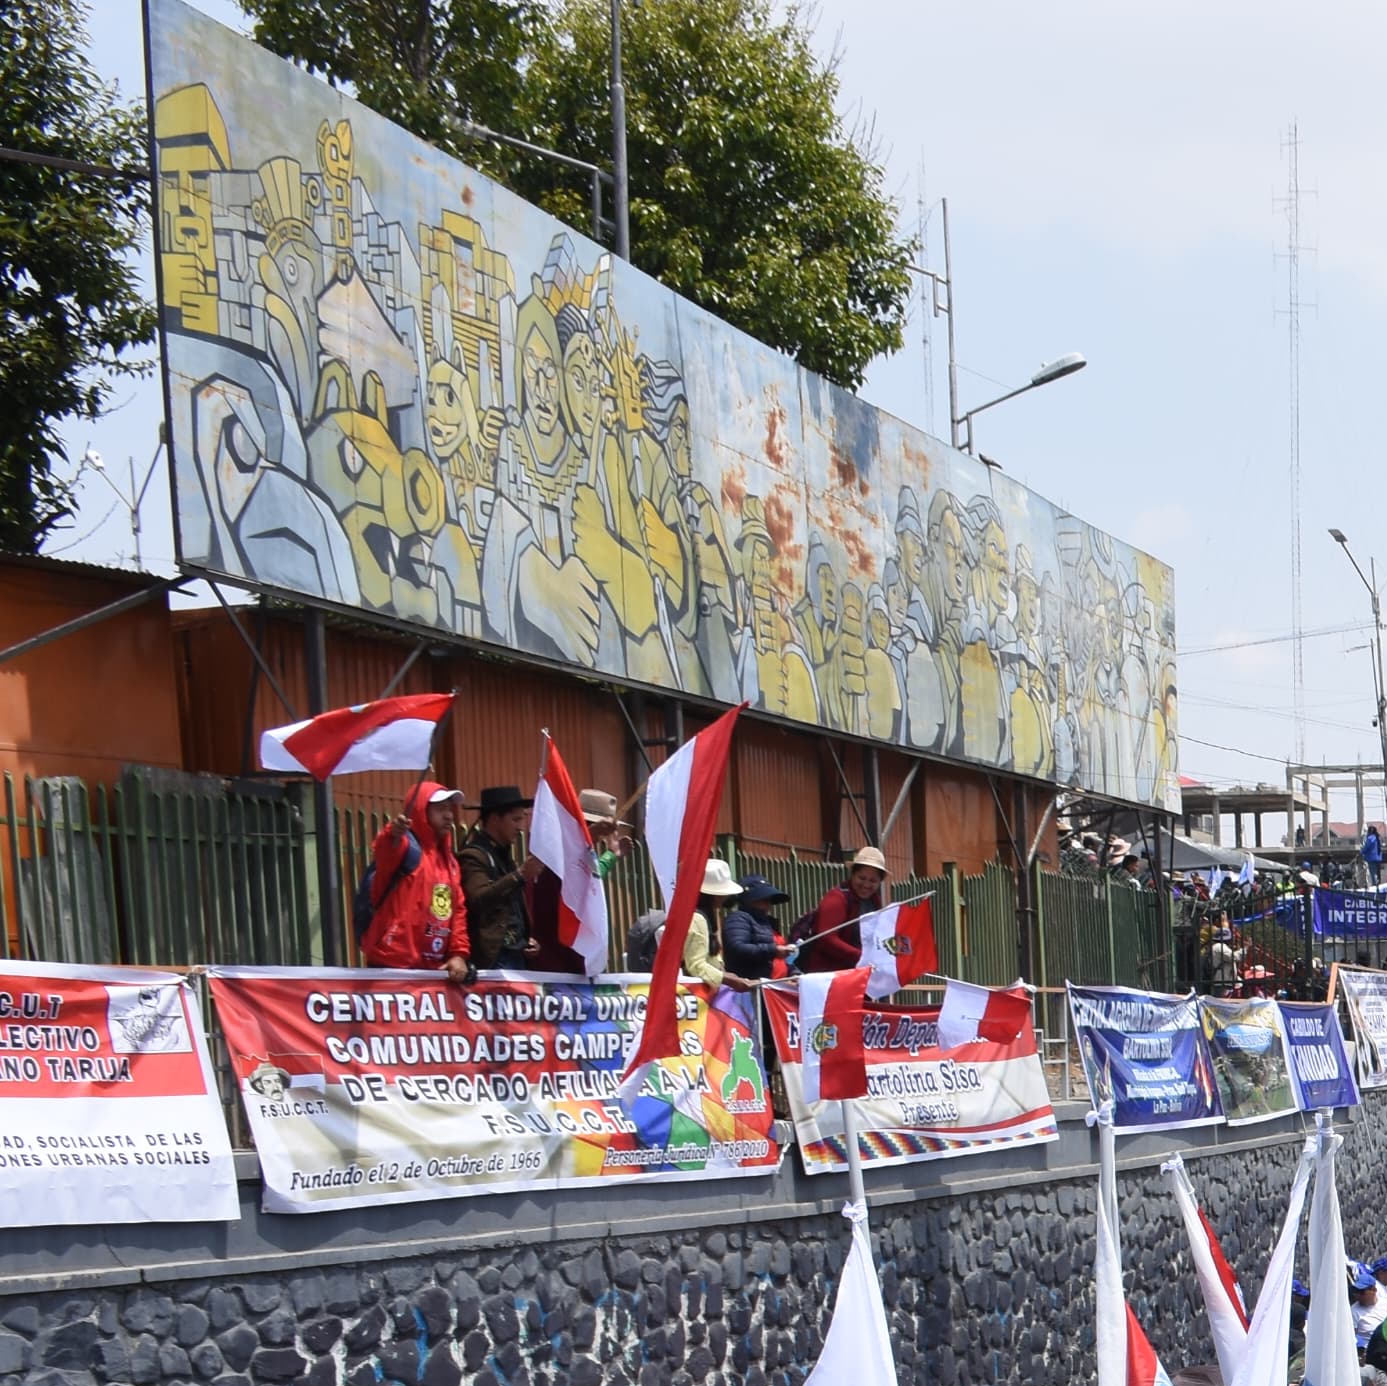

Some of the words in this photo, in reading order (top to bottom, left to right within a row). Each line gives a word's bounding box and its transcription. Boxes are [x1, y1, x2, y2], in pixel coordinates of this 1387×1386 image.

[306, 992, 455, 1023] CENTRAL
[466, 993, 587, 1022] SINDICAL
[326, 1032, 546, 1065] COMUNIDADES
[47, 1058, 132, 1082] TARIJA
[341, 1075, 388, 1103] DE
[396, 1072, 529, 1104] CERCADO
[659, 1067, 677, 1093] A
[684, 1064, 710, 1092] LA
[868, 1064, 937, 1098] artolina
[940, 1063, 982, 1093] Sisa
[902, 1101, 958, 1124] Presente
[37, 1134, 136, 1149] SOCIALISTA
[146, 1133, 169, 1147] DE
[173, 1132, 203, 1146] LAS
[49, 1152, 129, 1167] URBANAS
[135, 1150, 211, 1165] SOCIALES
[290, 1165, 363, 1191] Fundado
[369, 1166, 384, 1183] el
[389, 1163, 399, 1180] 2
[404, 1160, 423, 1179] de
[427, 1155, 483, 1178] Octubre
[488, 1155, 504, 1172] de
[511, 1152, 542, 1170] 1966
